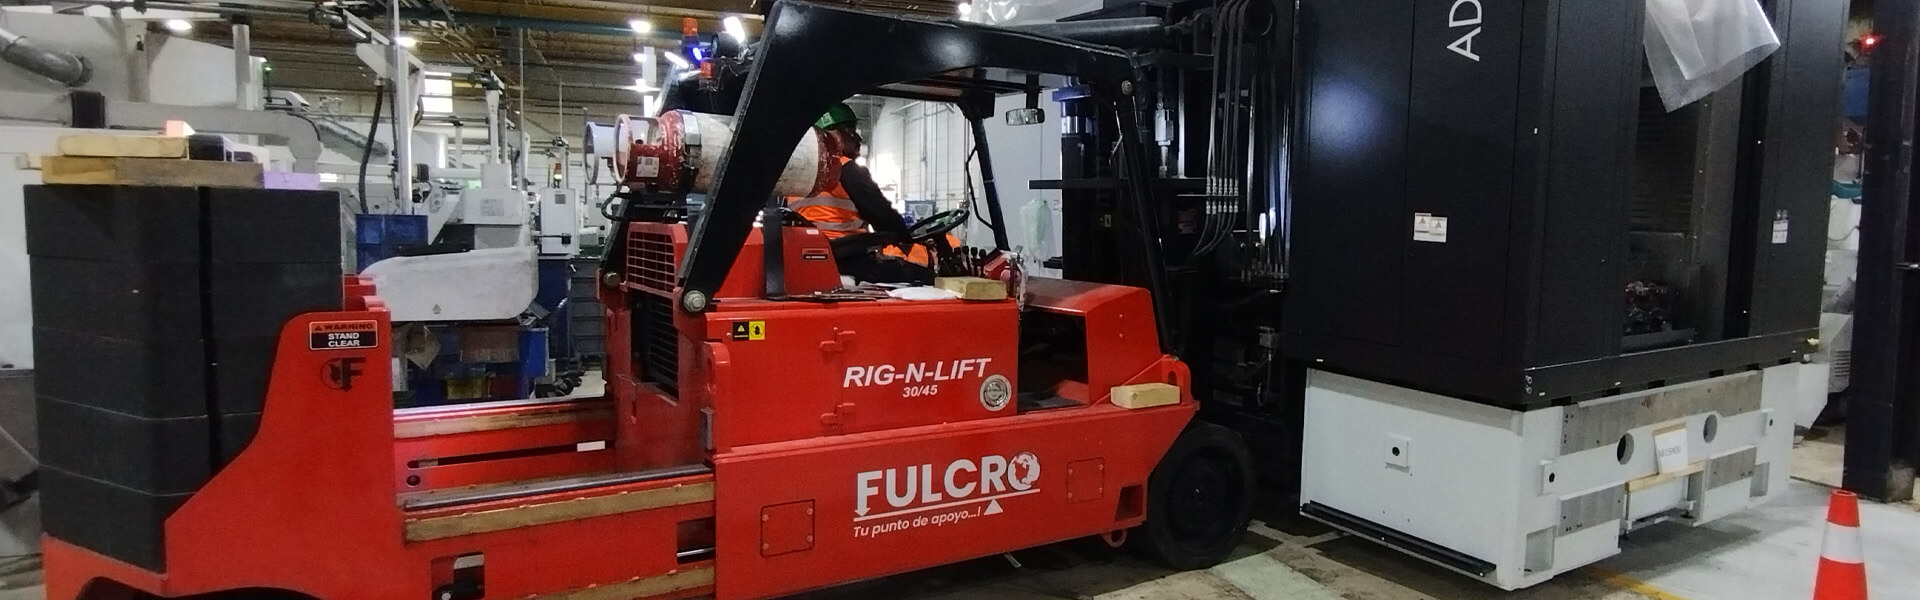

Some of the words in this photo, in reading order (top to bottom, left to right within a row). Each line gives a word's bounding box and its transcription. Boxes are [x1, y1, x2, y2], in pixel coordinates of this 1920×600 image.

[323, 323, 373, 331] WARNING
[328, 332, 360, 340] STAND
[328, 339, 361, 347] CLEAR
[843, 357, 992, 388] RIG-N-LIFT
[902, 384, 938, 398] 30/45
[855, 452, 1041, 517] FULCRO
[853, 525, 869, 538] Tu
[871, 518, 910, 538] punto
[912, 515, 929, 528] de
[931, 506, 982, 526] apoyo...!
